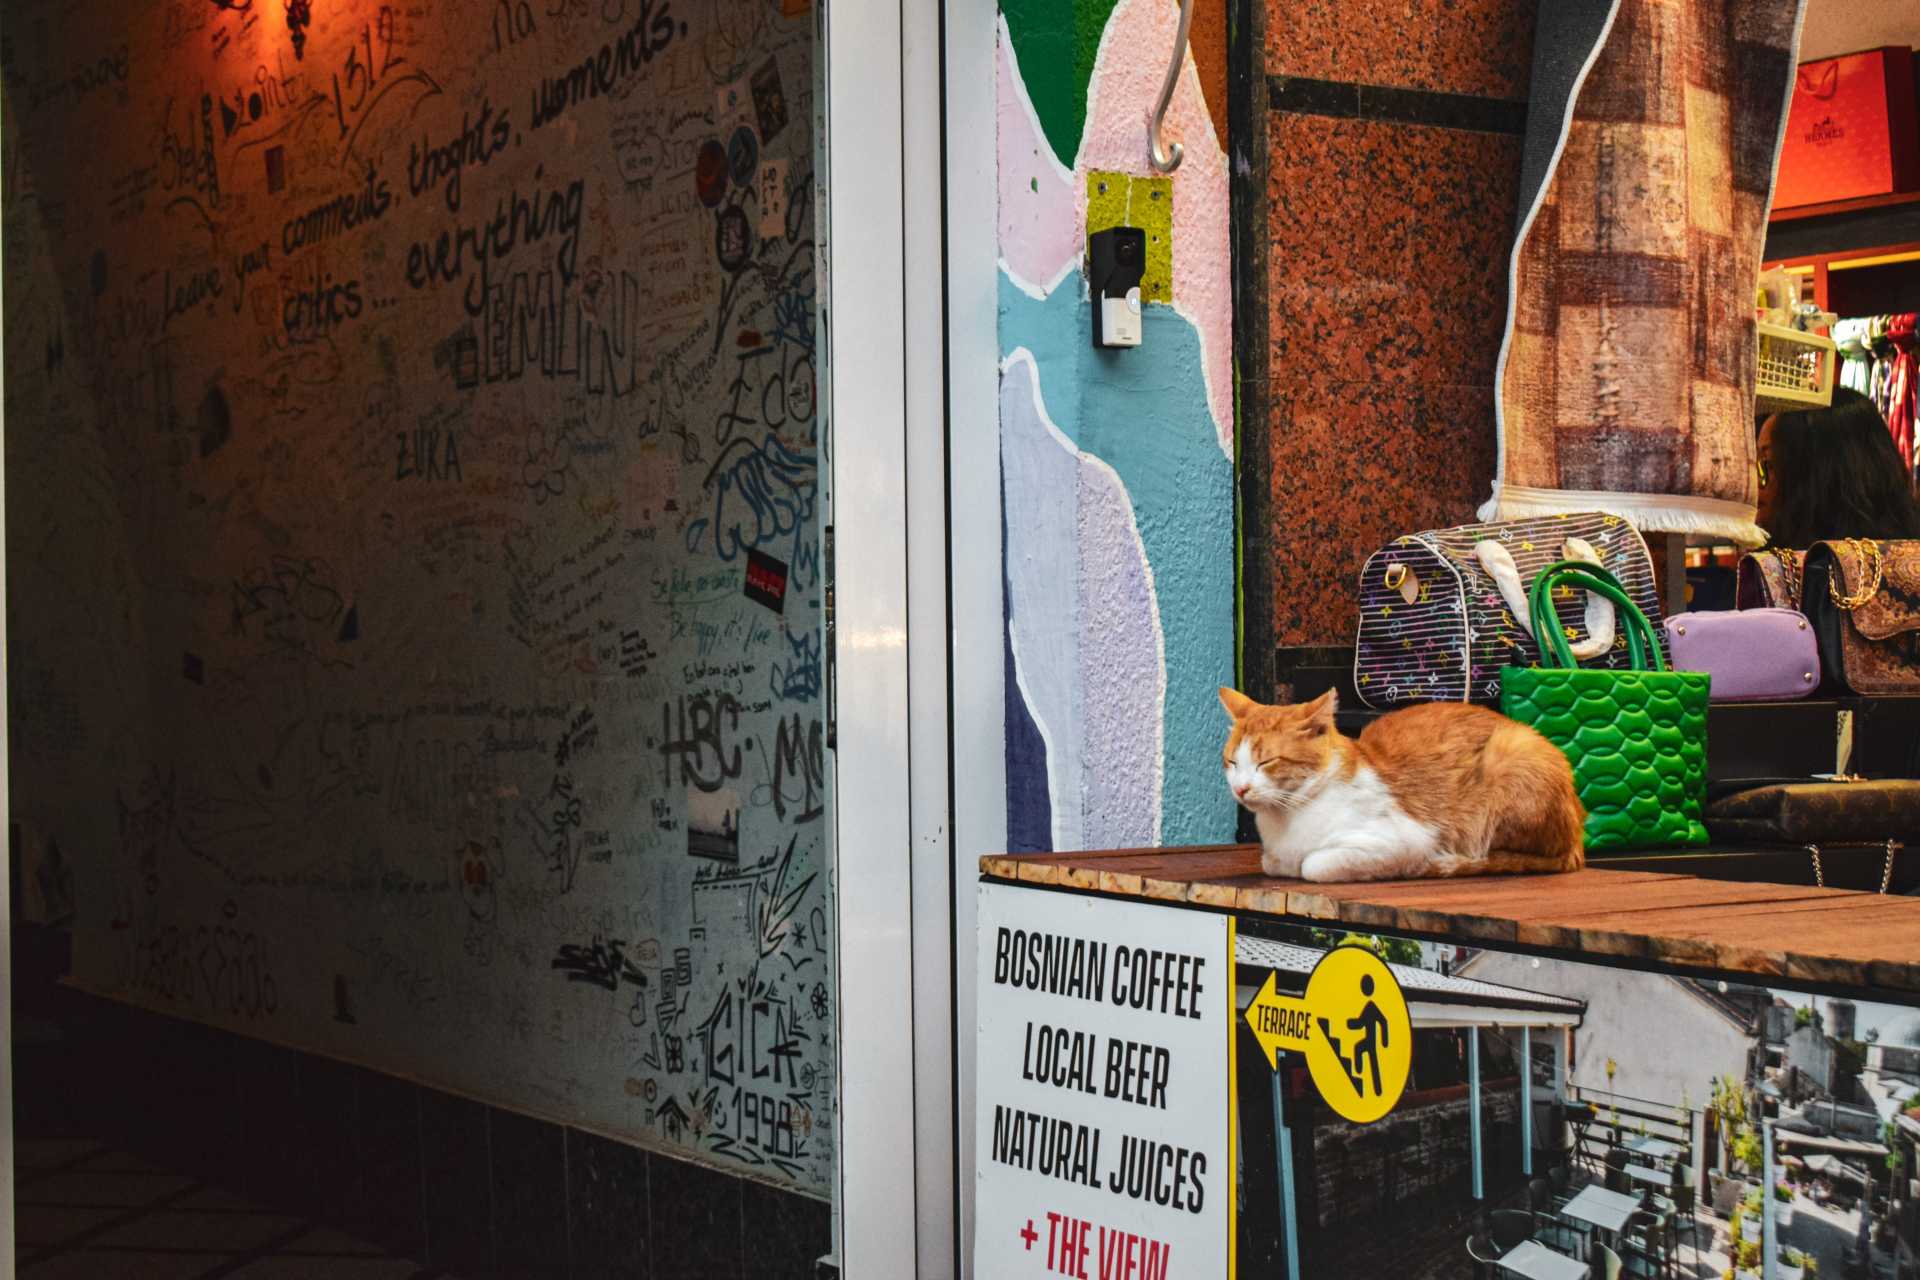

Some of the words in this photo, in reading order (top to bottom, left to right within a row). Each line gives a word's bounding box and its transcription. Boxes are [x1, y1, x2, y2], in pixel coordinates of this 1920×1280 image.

[405, 163, 583, 317] everything
[162, 266, 225, 331] Leave
[994, 927, 1107, 1002] BOSNIAN
[1111, 945, 1205, 1019] COFFEE
[1257, 1004, 1311, 1041] TERRACE
[1022, 1021, 1097, 1095] LOCAL
[1104, 1038, 1170, 1109] BEER
[732, 1086, 794, 1159] 1998
[992, 1104, 1101, 1189] NATURAL
[1109, 1134, 1207, 1214] JUICES
[1047, 1211, 1092, 1280] THE
[1099, 1226, 1170, 1280] VIEW
